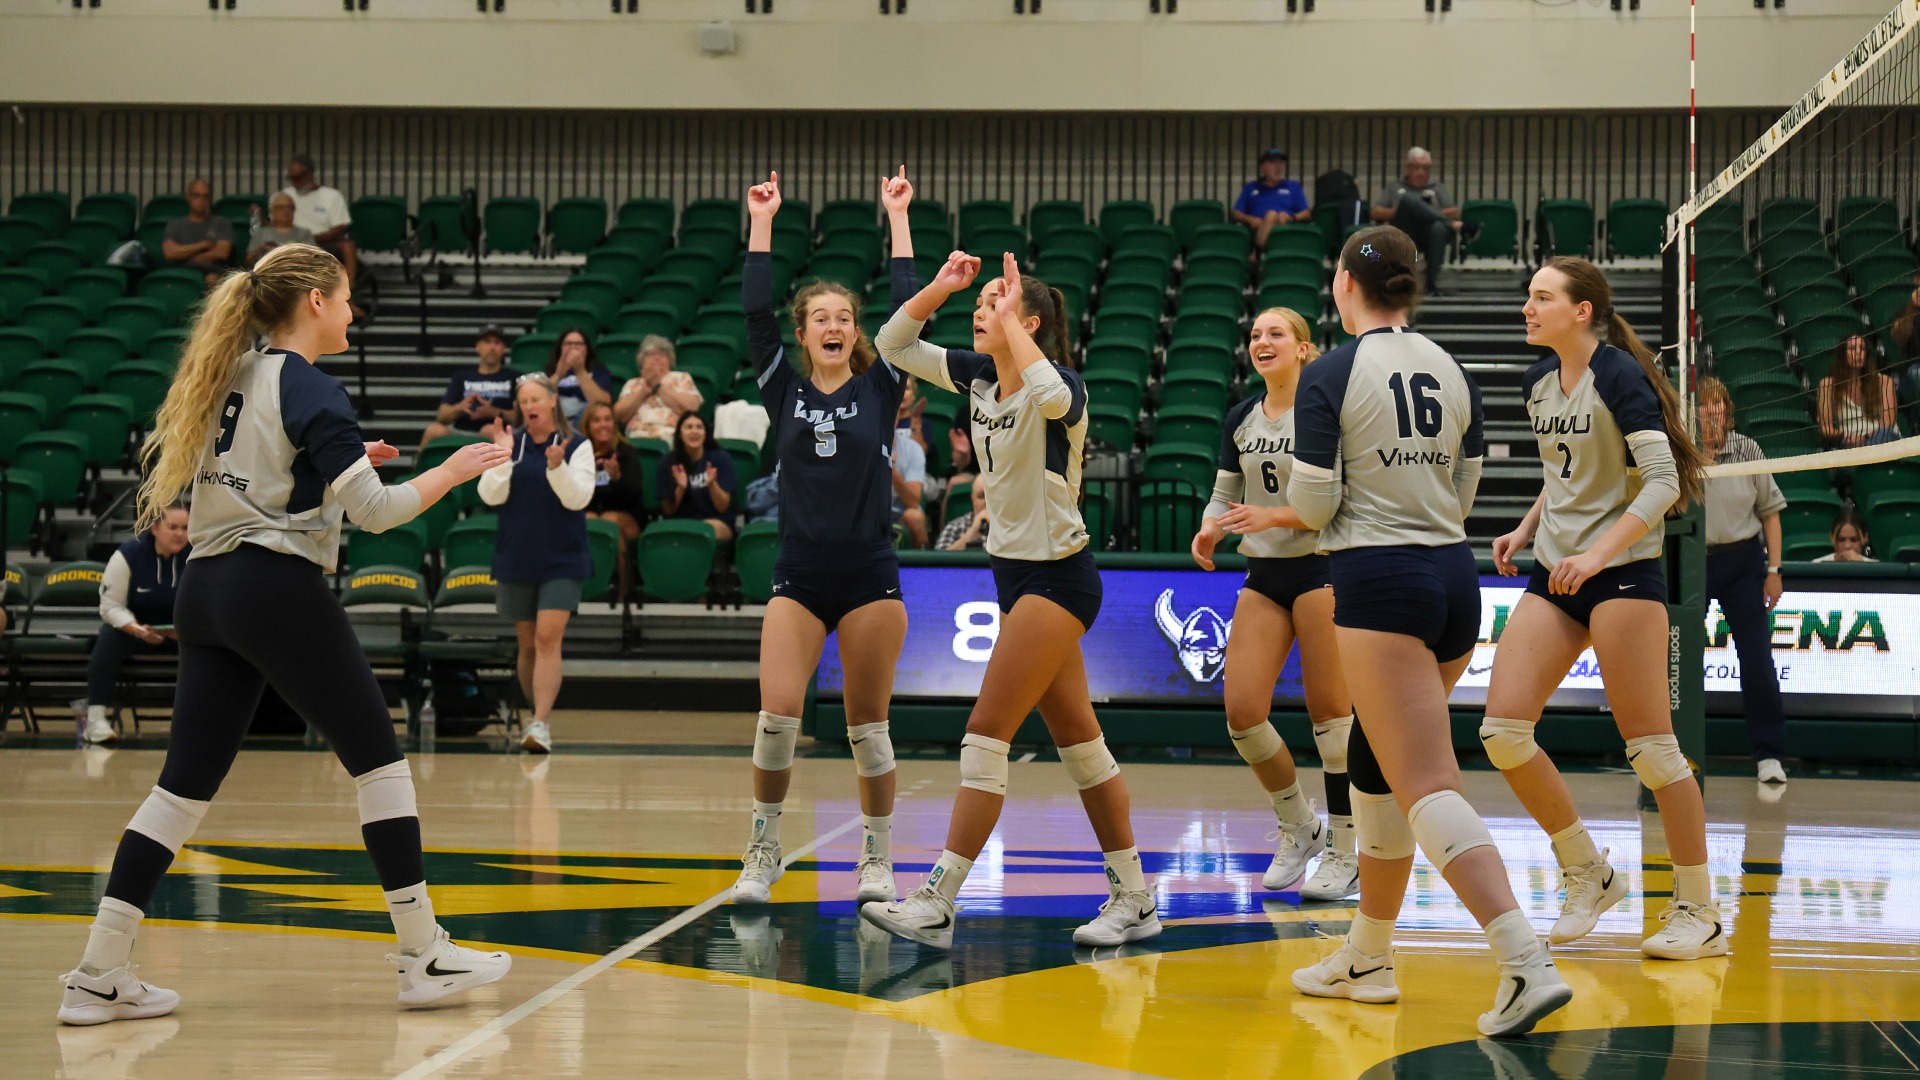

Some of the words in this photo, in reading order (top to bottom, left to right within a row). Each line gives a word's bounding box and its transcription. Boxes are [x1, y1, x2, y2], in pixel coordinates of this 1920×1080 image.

[214, 390, 245, 458] 9
[1388, 371, 1443, 440] 16
[1534, 413, 1591, 435] WWU
[814, 420, 837, 458] 5
[984, 435, 994, 473] 1
[1260, 460, 1280, 494] 6
[1556, 441, 1573, 479] 2
[47, 570, 104, 585] BRONCO
[351, 573, 417, 590] BRONCOS
[952, 601, 1000, 662] 8
[1668, 625, 1681, 663] sports
[1668, 664, 1681, 710] imports
